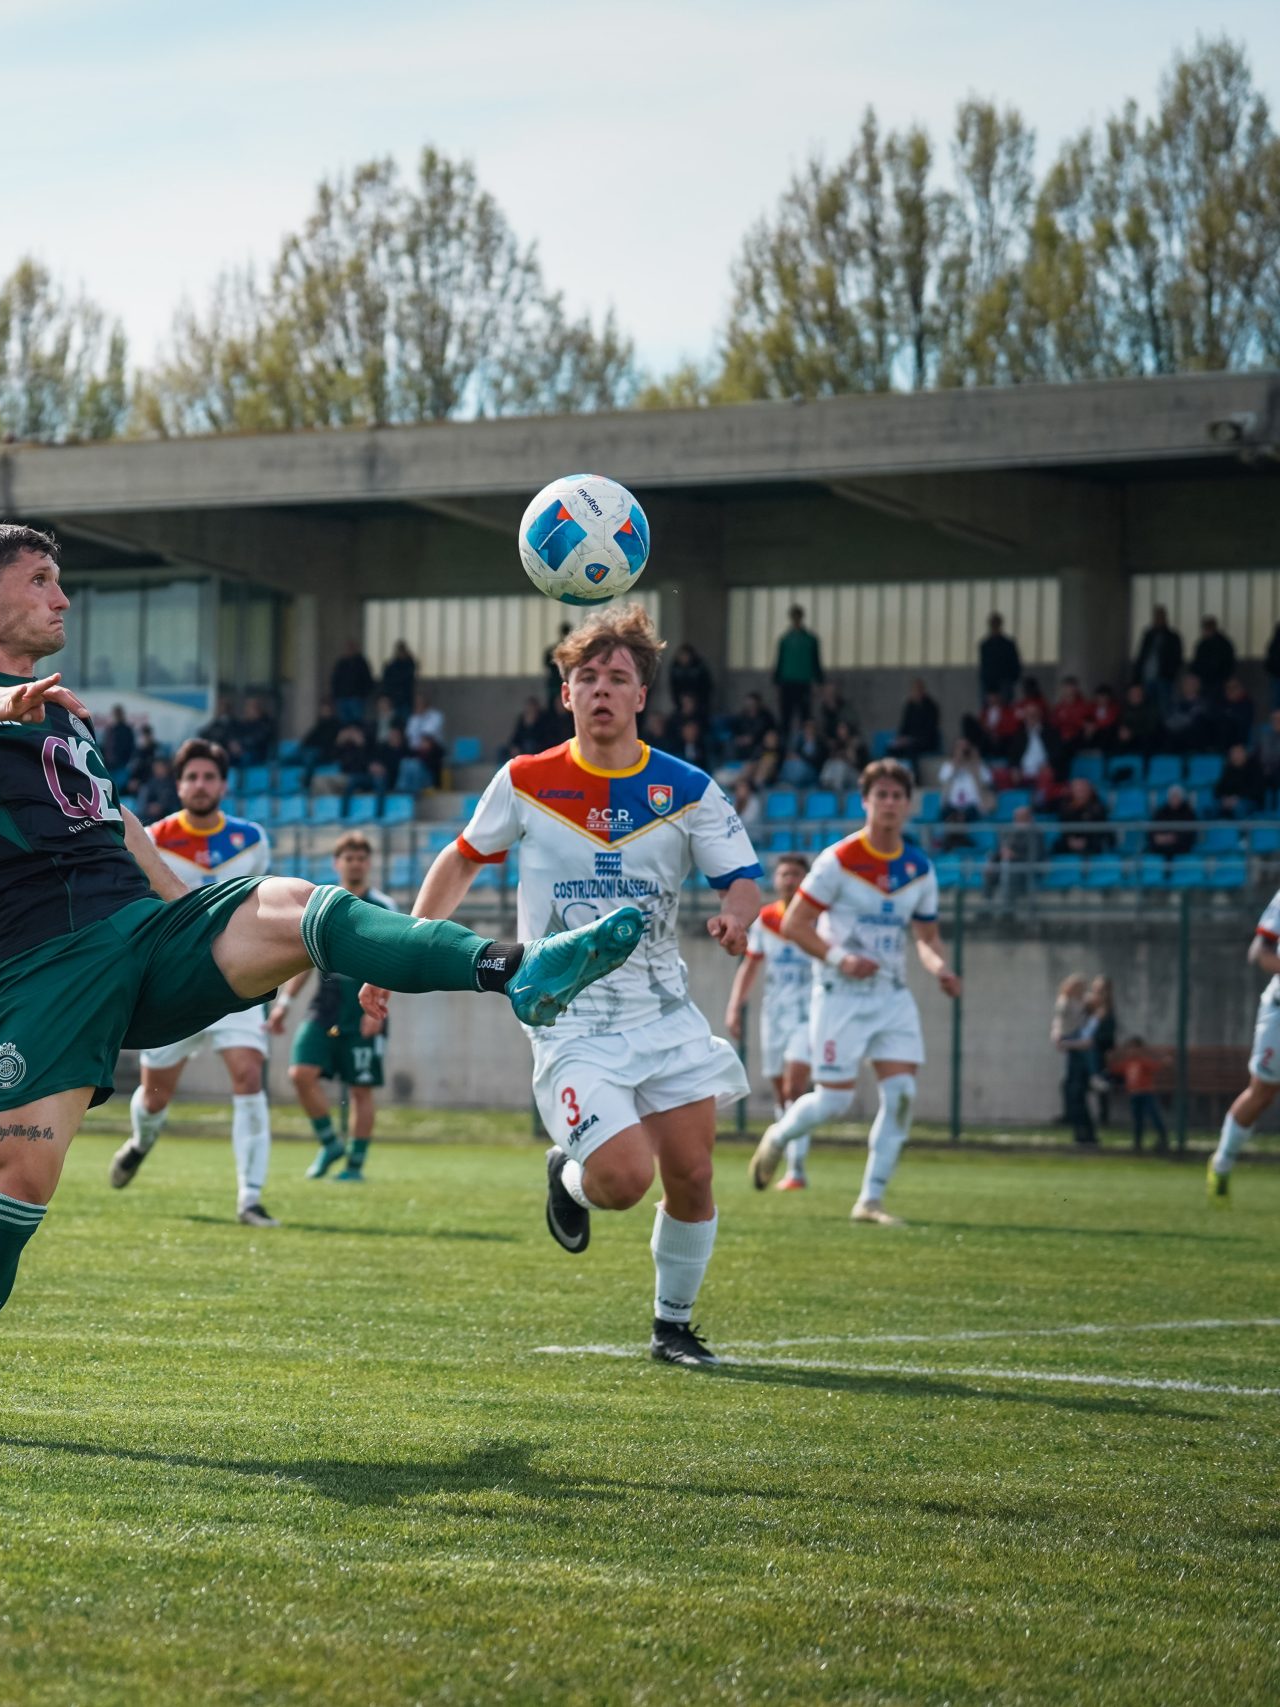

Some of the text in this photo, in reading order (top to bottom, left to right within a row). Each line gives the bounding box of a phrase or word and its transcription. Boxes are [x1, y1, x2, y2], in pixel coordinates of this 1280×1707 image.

[577, 488, 603, 517] molten
[553, 879, 659, 899] COSTRUZIONI SASSELLA
[561, 1086, 580, 1127] 3
[567, 1113, 599, 1147] LEGEA
